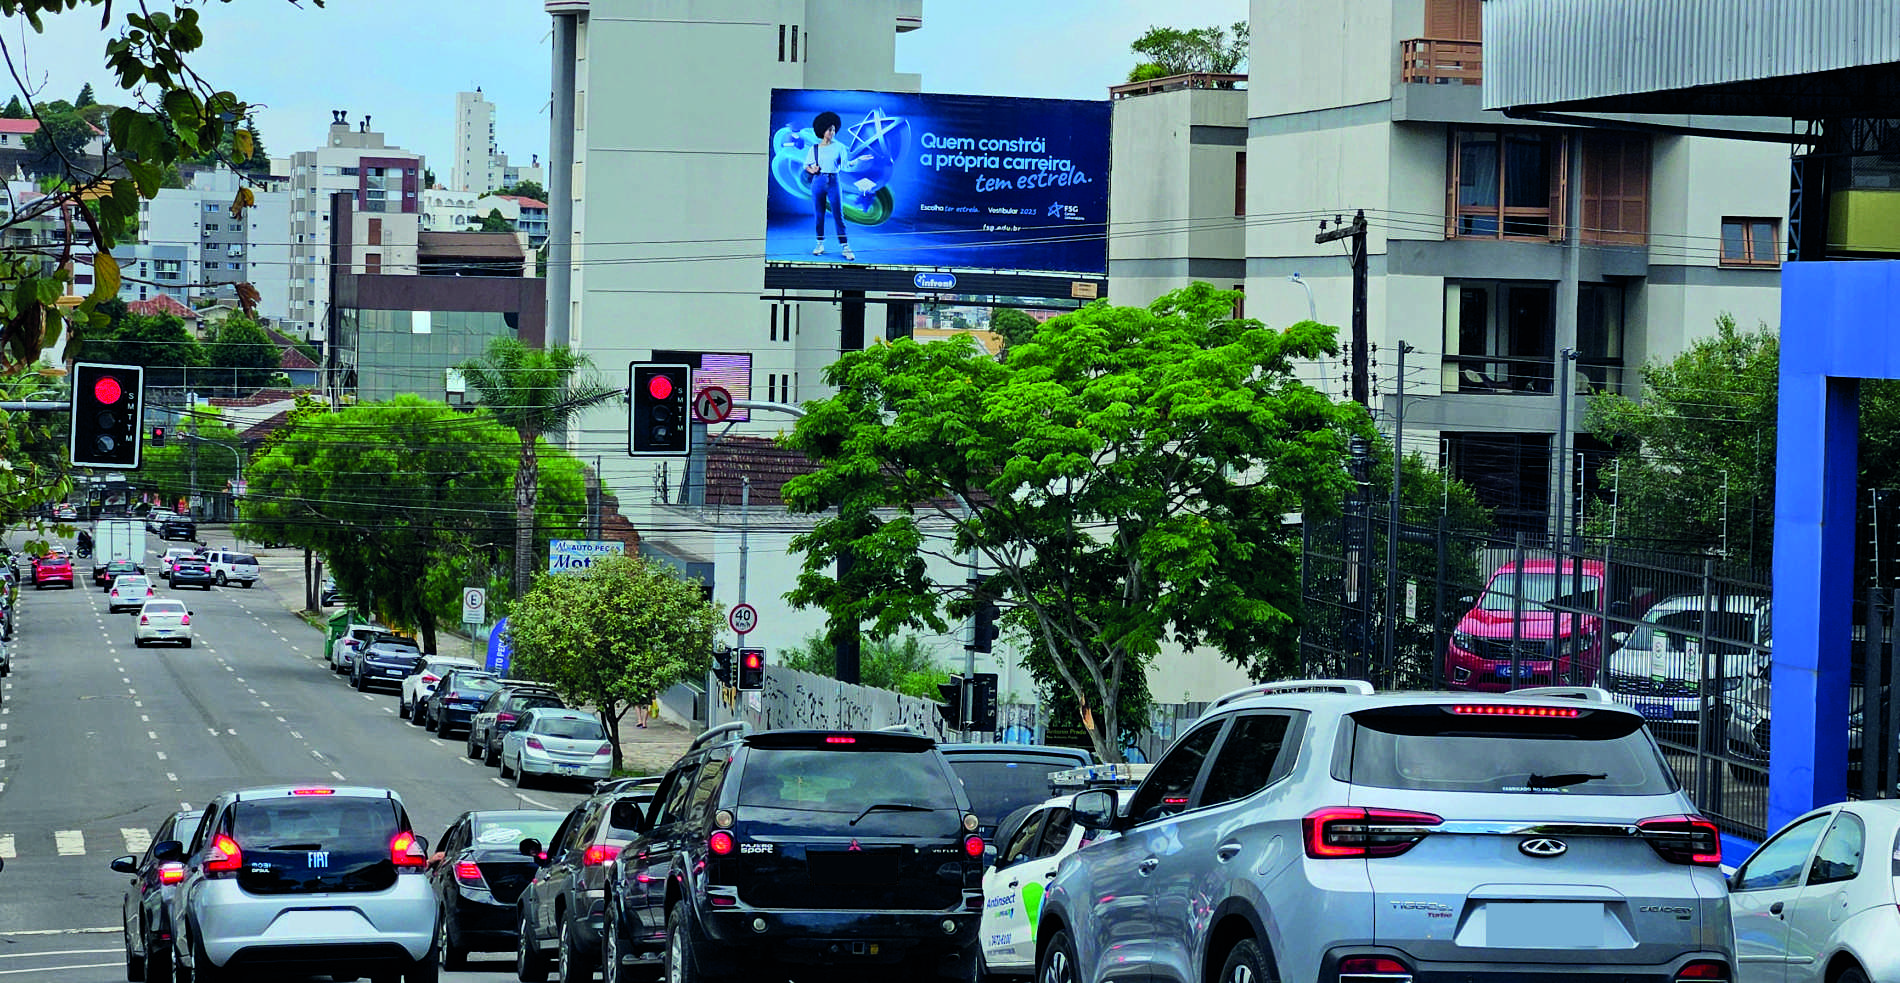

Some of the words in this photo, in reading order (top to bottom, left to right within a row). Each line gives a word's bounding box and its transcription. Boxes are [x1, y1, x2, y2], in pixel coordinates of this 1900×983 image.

[921, 132, 975, 150] Quem
[978, 136, 1046, 154] constrói
[920, 153, 933, 166] a
[936, 151, 1000, 173] própria
[975, 174, 1013, 193] tem
[1016, 165, 1093, 189] estrela.
[920, 203, 944, 212] Escolha
[987, 206, 1019, 215] Vestibular
[1064, 205, 1079, 213] FSG
[571, 544, 593, 552] AUTO
[470, 594, 478, 606] E
[735, 609, 751, 621] 40
[307, 851, 330, 868] FIAT
[986, 893, 1016, 908] Antinsect
